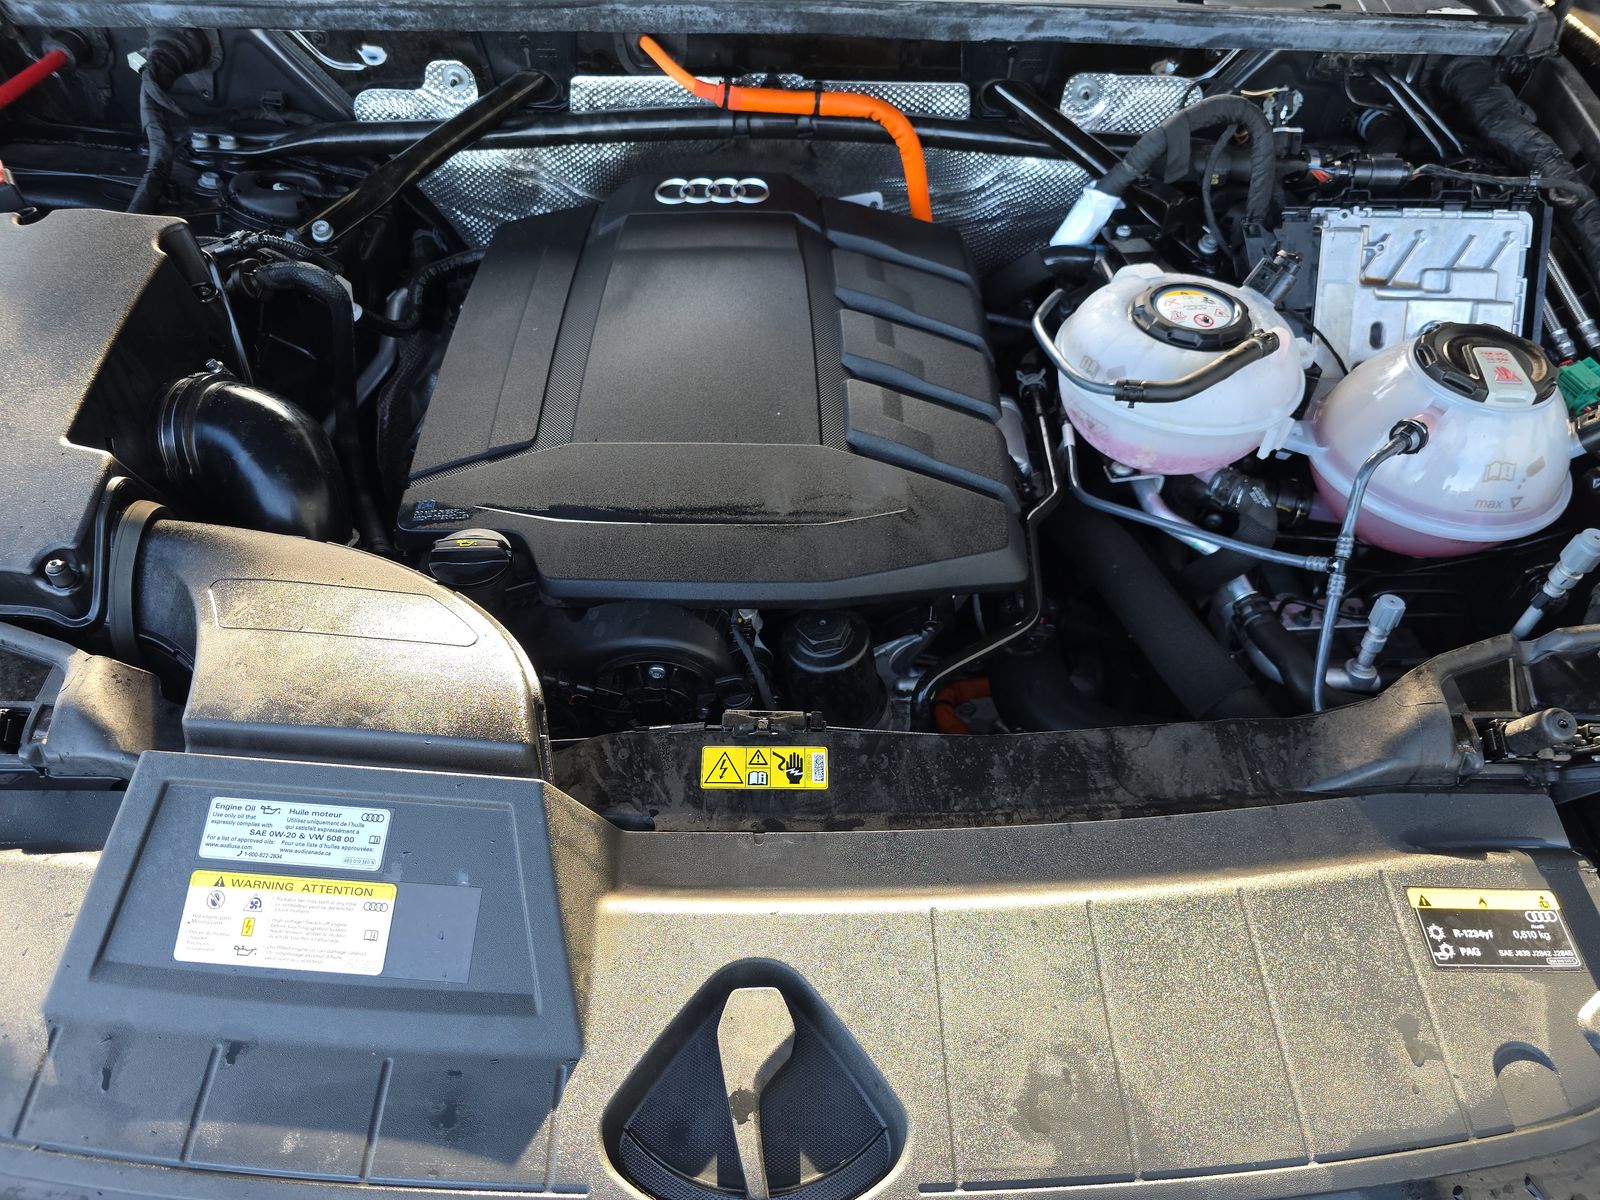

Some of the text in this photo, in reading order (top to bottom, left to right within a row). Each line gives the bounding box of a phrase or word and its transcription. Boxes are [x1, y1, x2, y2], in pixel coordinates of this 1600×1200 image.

[1475, 499, 1504, 509] max
[216, 803, 242, 811] Engine
[289, 808, 309, 816] Huile
[205, 842, 253, 850] www.audiusa.com
[231, 879, 374, 897] WARNING ATTENTION
[1453, 929, 1494, 940] R-1234yf
[1538, 930, 1551, 941] kg
[1459, 947, 1481, 957] PAG
